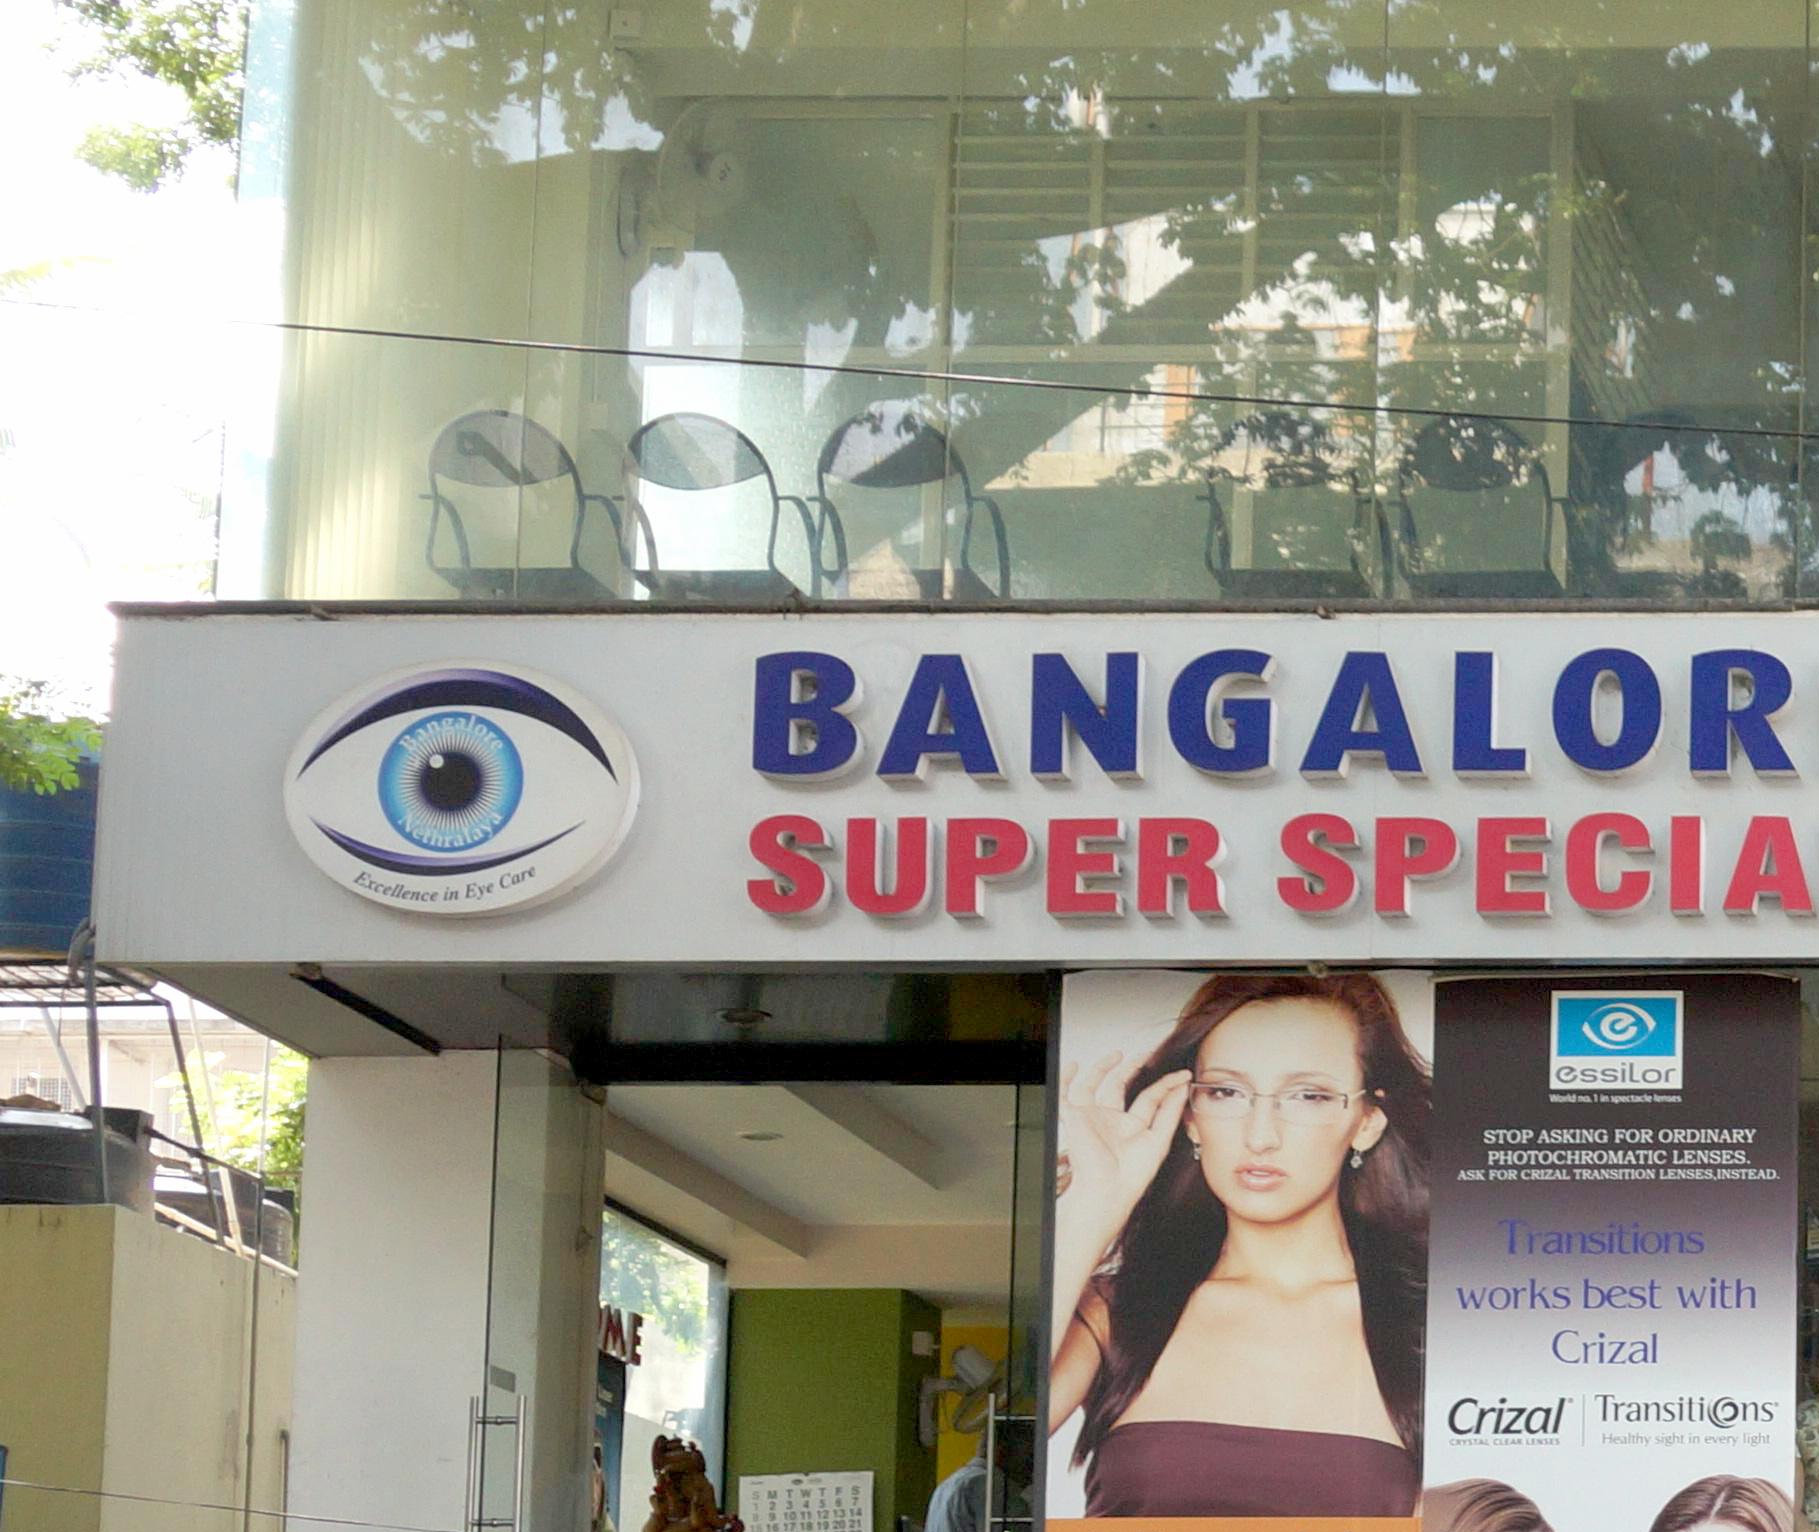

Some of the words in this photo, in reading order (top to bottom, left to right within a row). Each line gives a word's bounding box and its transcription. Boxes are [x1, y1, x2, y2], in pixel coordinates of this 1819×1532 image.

[398, 714, 505, 753] Bangalore
[747, 812, 1232, 918] SUPER
[353, 870, 439, 903] Excellence
[443, 886, 459, 902] in
[464, 883, 494, 901] Eye
[499, 864, 537, 889] Care
[1483, 1129, 1534, 1145] STOP
[1537, 1128, 1609, 1145] ASKING
[1613, 1129, 1654, 1145] FOR
[1657, 1128, 1758, 1144] ORDINARY
[1456, 1168, 1486, 1181] ASK
[1488, 1168, 1518, 1181] FOR
[1520, 1168, 1571, 1181] CRIZAL
[1573, 1168, 1656, 1181] TRANSITION
[1487, 1149, 1668, 1167] PHOTOCHROMATIC
[1672, 1149, 1752, 1165] LENSES.
[1497, 1217, 1706, 1255] Transitions
[1455, 1278, 1571, 1310] works
[1581, 1277, 1662, 1310] best
[1676, 1276, 1757, 1310] with
[1551, 1329, 1659, 1365] Crizal
[1447, 1397, 1567, 1435] Crizal
[1601, 1432, 1652, 1447] Healthy
[1654, 1432, 1685, 1447] sight
[1688, 1432, 1701, 1445] in
[1703, 1434, 1740, 1447] every
[1742, 1431, 1771, 1447] light
